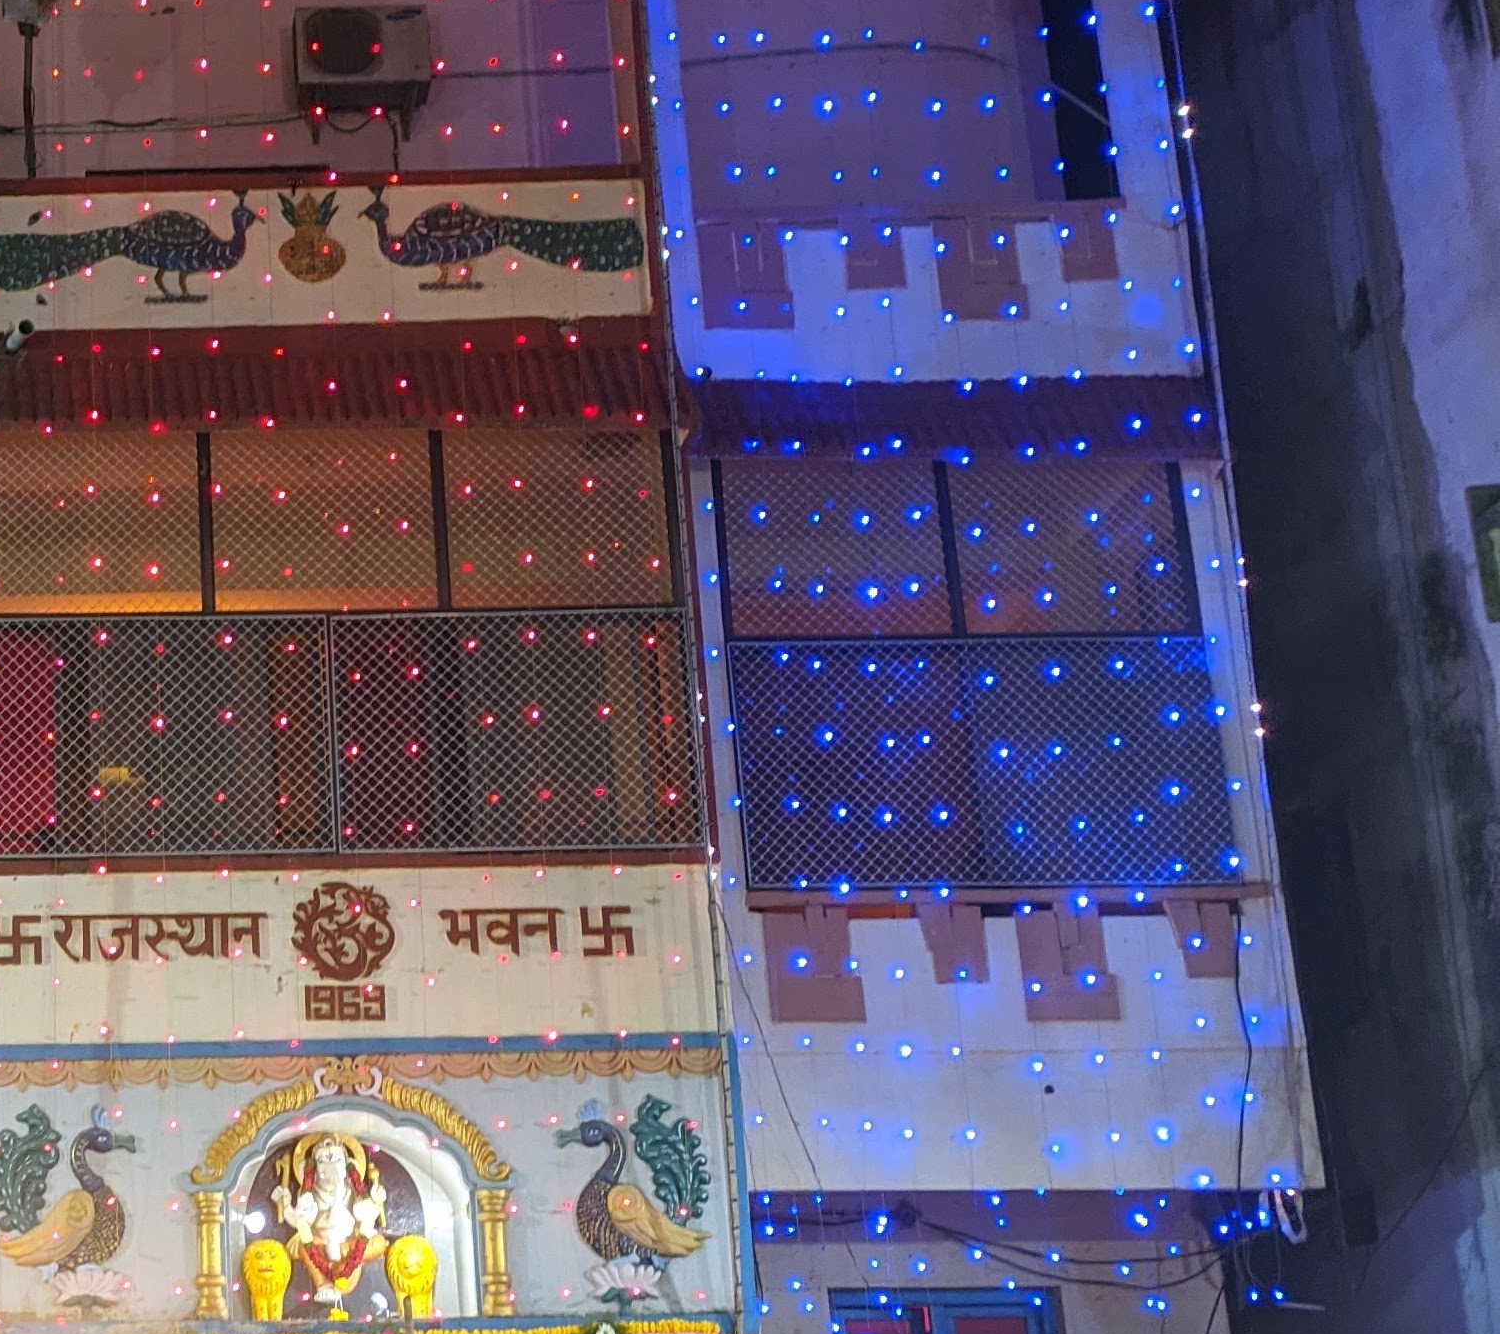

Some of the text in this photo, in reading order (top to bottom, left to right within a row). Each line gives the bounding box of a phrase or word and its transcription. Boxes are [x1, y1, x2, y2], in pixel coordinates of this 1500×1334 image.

[49, 906, 563, 964] राजस्थान भवन
[304, 984, 387, 1022] 1969
